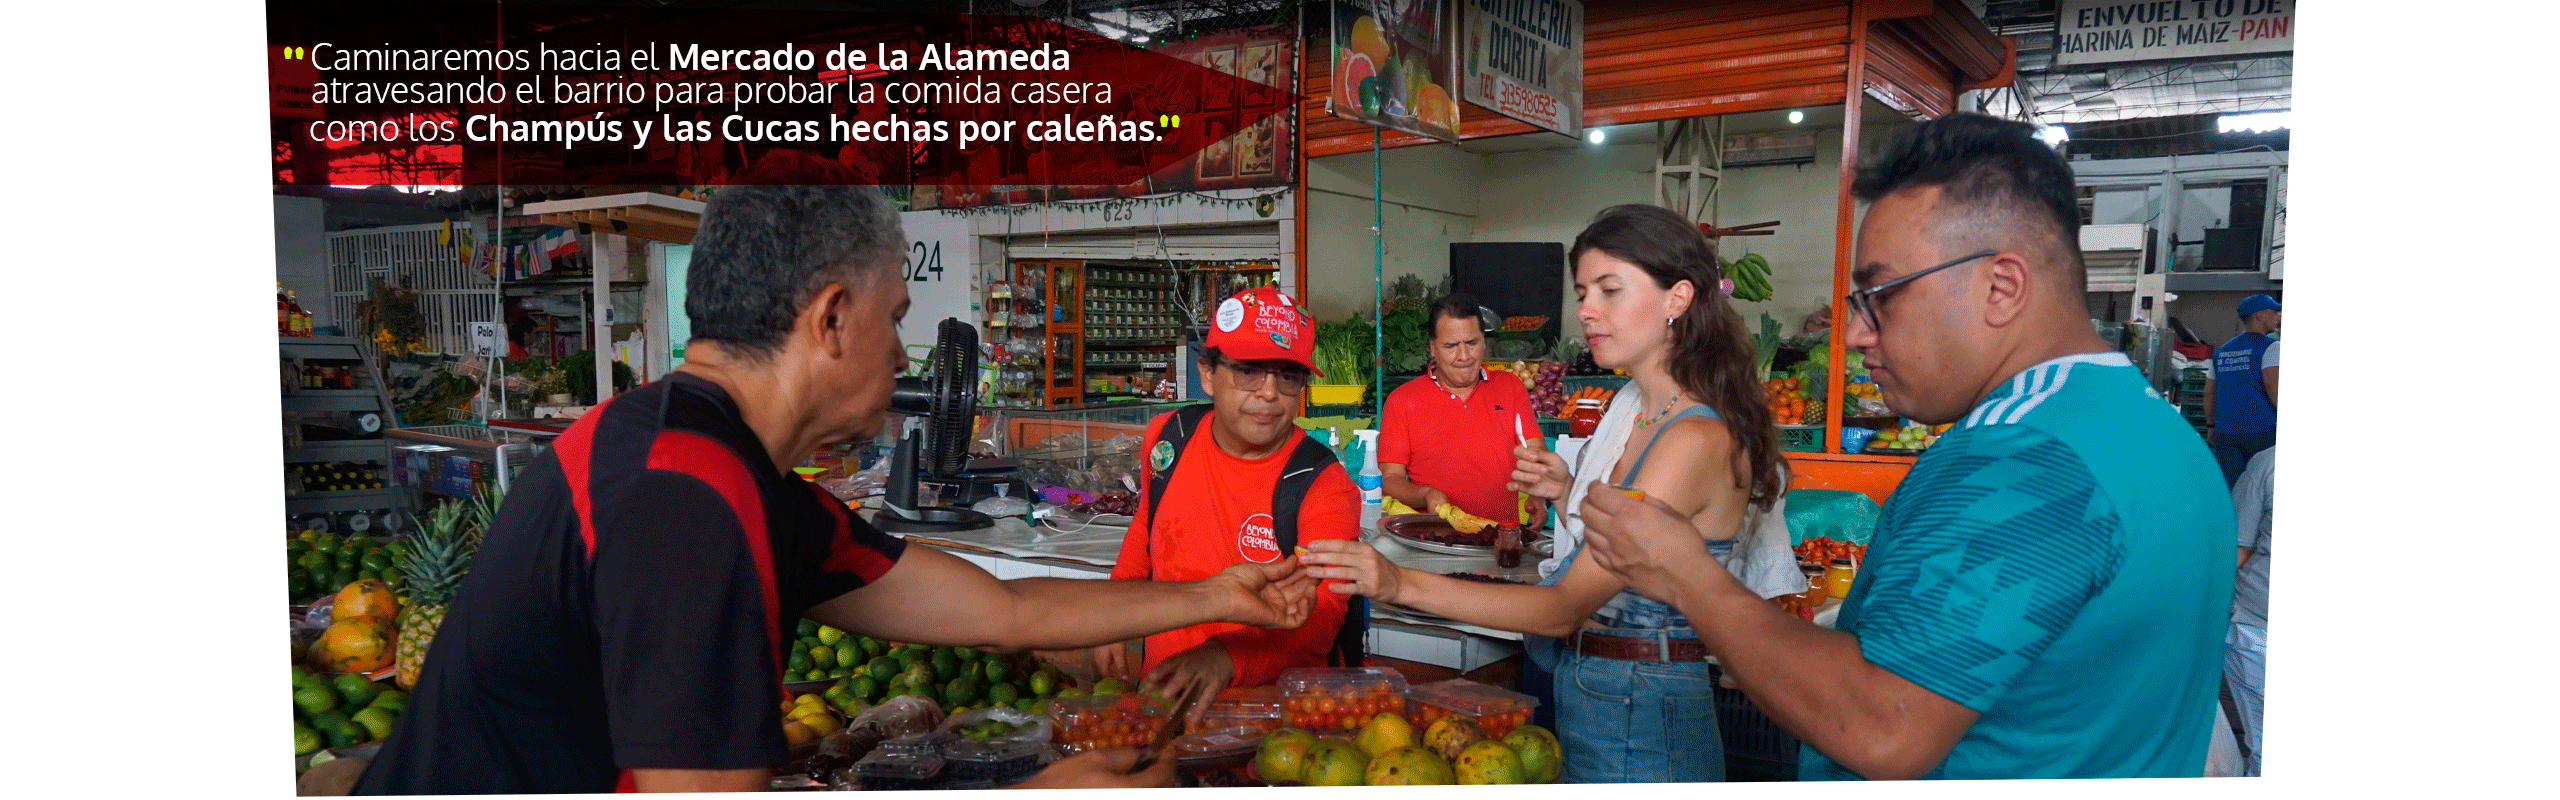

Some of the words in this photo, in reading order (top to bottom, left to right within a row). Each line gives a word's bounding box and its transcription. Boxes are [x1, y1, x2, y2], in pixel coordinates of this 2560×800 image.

[1470, 0, 1572, 50] TILLERIA
[2077, 0, 2235, 29] ENVUELTO
[2243, 0, 2282, 16] DE
[2059, 28, 2134, 54] HARINA
[2142, 25, 2169, 48] DE
[1488, 20, 1548, 89] DORITA
[1480, 72, 1495, 101] TEL
[1103, 201, 1133, 223] 623
[1258, 304, 1296, 322] BEYOND
[477, 325, 494, 337] Palo
[1254, 317, 1298, 336] COLOMBIA
[1242, 535, 1280, 552] COLOMBIA
